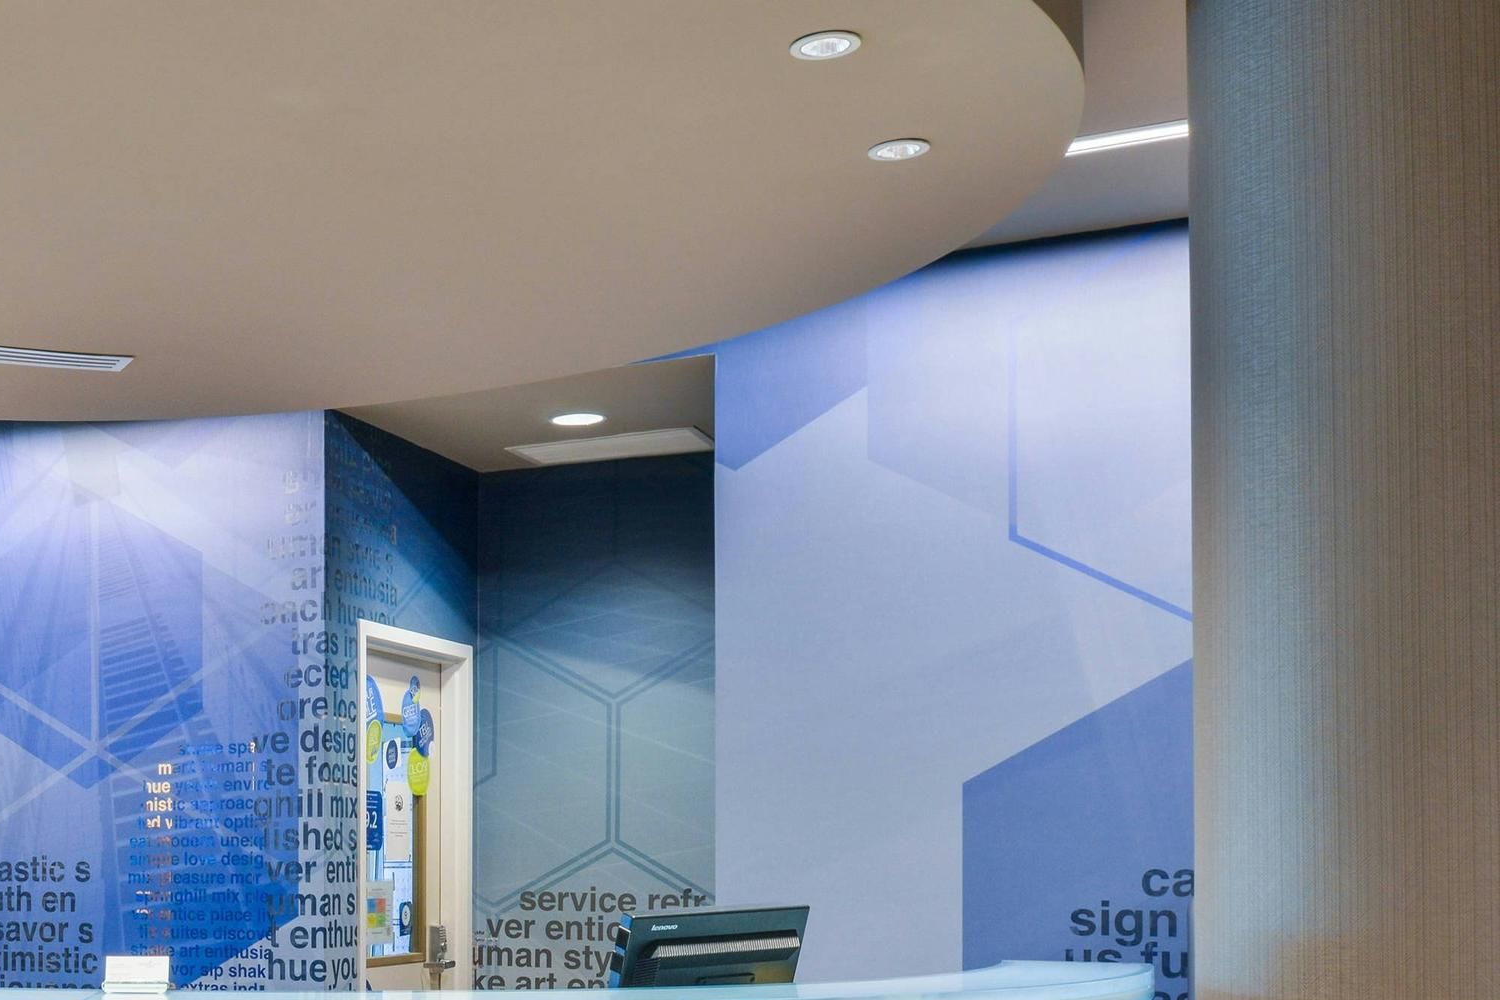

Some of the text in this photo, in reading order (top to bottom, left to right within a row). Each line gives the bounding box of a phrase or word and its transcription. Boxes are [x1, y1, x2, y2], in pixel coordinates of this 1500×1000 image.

[305, 756, 357, 785] focus
[331, 793, 357, 818] mix
[1142, 869, 1194, 896] ca
[41, 891, 76, 912] en
[519, 886, 637, 913] service
[209, 907, 252, 923] place
[1070, 901, 1178, 947] sign
[78, 922, 93, 943] s
[486, 917, 535, 939] ver
[546, 916, 620, 942] entic
[179, 945, 200, 957] art
[200, 964, 224, 980] sip
[228, 964, 266, 978] shak
[268, 950, 327, 982] hue
